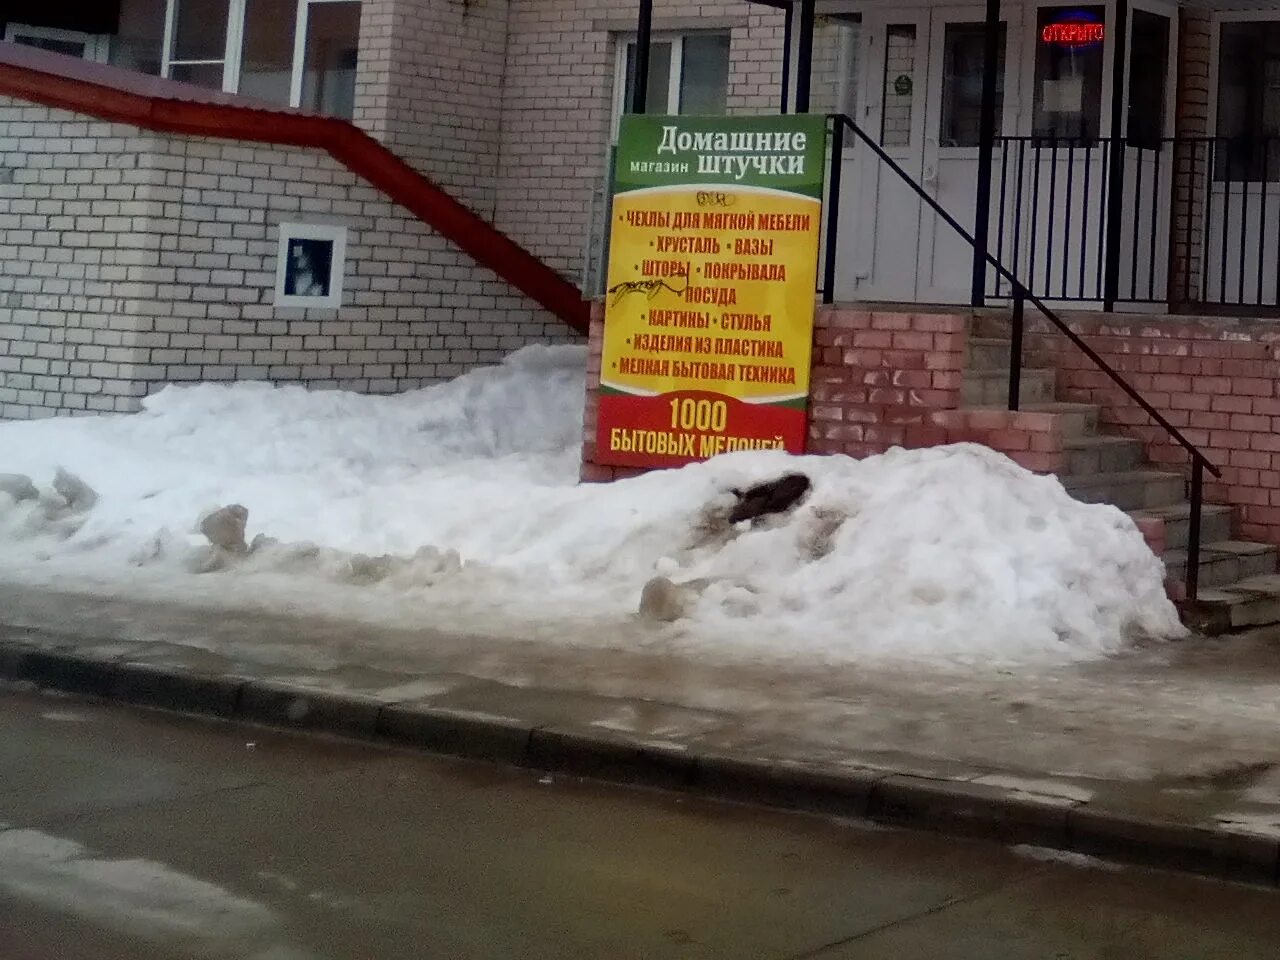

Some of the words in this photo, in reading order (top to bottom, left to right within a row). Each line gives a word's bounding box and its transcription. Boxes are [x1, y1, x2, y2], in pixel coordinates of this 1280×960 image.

[657, 126, 806, 155] Домашние
[630, 161, 689, 174] магазин
[697, 155, 805, 179] штучки
[627, 211, 670, 229] ЧЕХЛЫ
[672, 212, 700, 231] ДЛЯ
[702, 211, 754, 231] МЯГКОЙ
[758, 214, 810, 232] МЕБЕЛИ
[656, 236, 720, 254] ХРУСТАЛЬ
[734, 239, 773, 256] ВАЗЫ
[642, 260, 690, 278] ШТОРЫ
[704, 263, 786, 282] ПОКРЫВАЛА
[685, 287, 737, 306] ПОСУДА
[649, 309, 710, 329] КАРТИНЫ
[721, 314, 772, 332] СТУЛЬЯ
[633, 333, 692, 354] ИЗДЕЛИЯ
[695, 337, 712, 355] ИЗ
[714, 338, 784, 358] ПЛАСТИКА
[619, 357, 669, 376] МЕЛКАЯ
[672, 361, 736, 381] БЫТОВАЯ
[739, 365, 796, 385] ТЕХНИКА
[670, 398, 727, 432] 1000
[610, 428, 695, 458] БЫТОВЫХ
